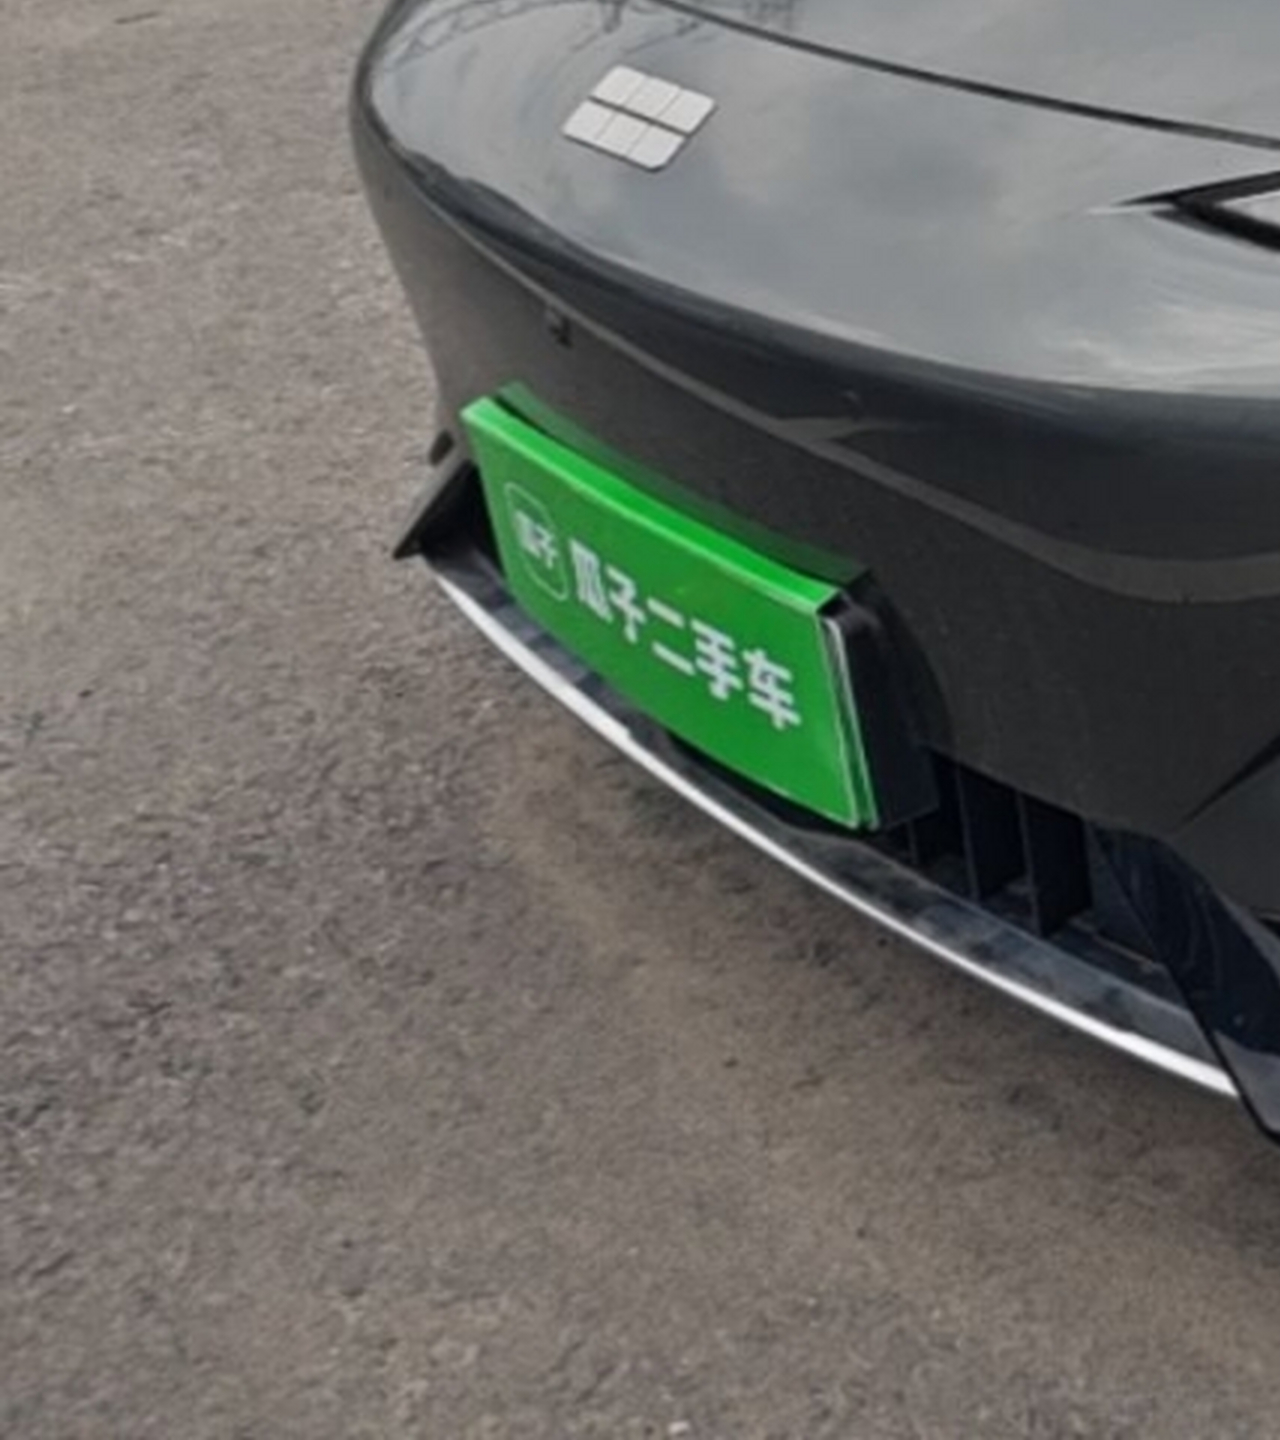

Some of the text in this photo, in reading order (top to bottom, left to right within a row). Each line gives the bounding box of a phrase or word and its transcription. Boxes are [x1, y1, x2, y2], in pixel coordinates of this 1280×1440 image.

[570, 539, 801, 730] 瓜子二手车
